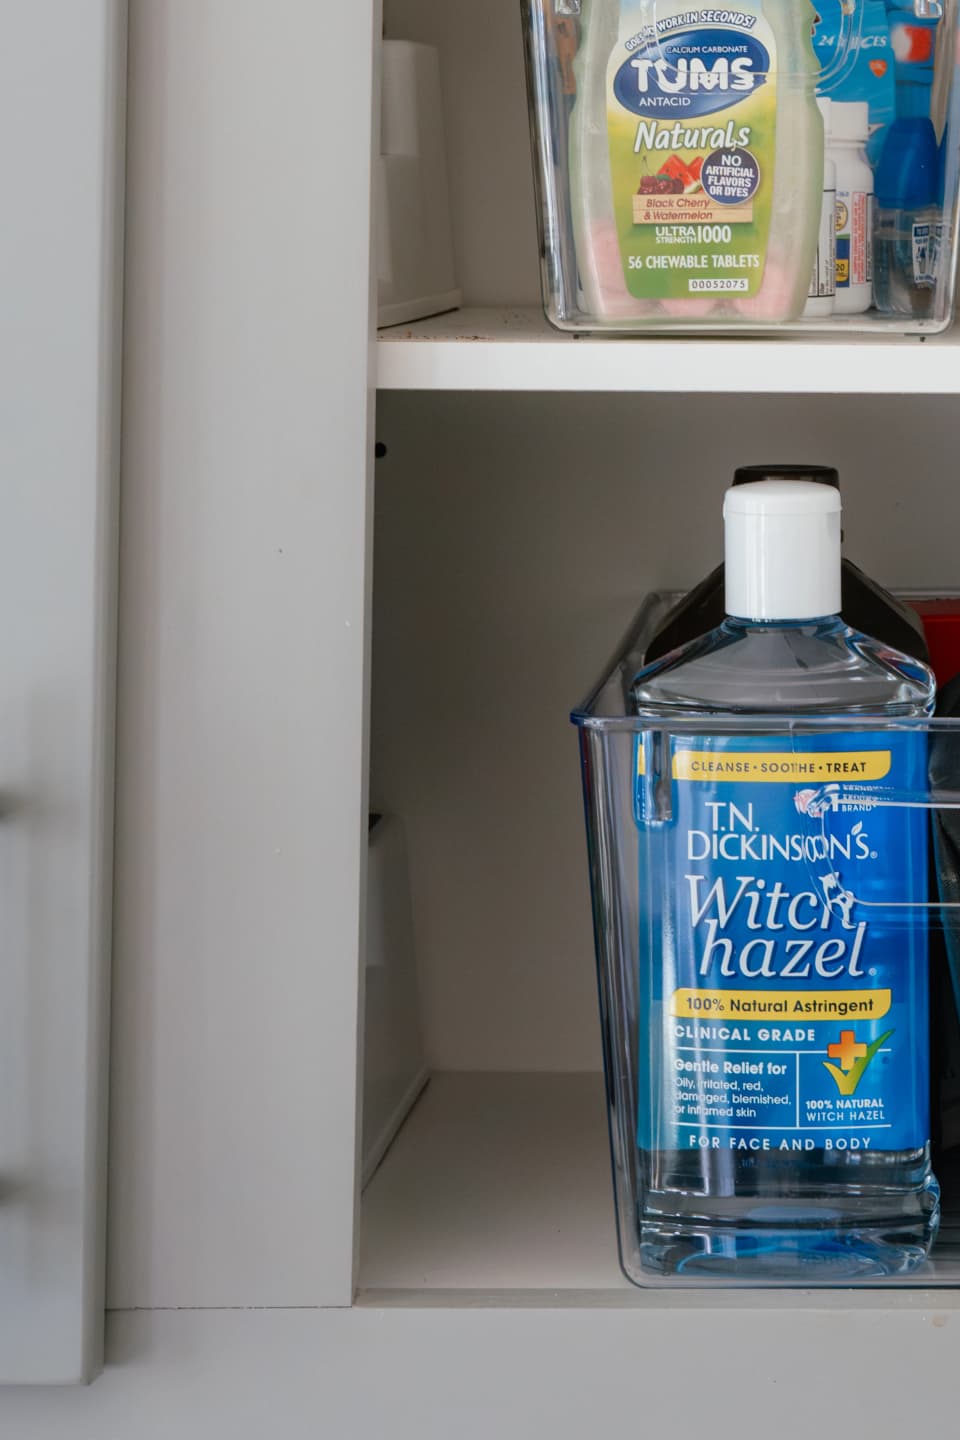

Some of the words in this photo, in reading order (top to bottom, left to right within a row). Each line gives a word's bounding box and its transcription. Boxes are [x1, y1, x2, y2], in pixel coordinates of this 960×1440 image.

[656, 16, 685, 32] WORK
[686, 11, 698, 24] IN
[700, 10, 756, 28] SECONDS!
[818, 35, 835, 47] 24
[666, 46, 700, 54] CALCIUM
[702, 46, 748, 54] CARBONATE
[631, 57, 754, 93] TUMS
[640, 96, 690, 107] ANTACID
[634, 120, 750, 152] Naturals
[721, 155, 742, 166] NO
[706, 167, 754, 178] ARTIFICIAL
[708, 176, 752, 188] FLAVORS
[710, 187, 724, 196] OR
[725, 188, 749, 198] DYES
[646, 199, 673, 208] Black
[676, 199, 710, 210] Cherry
[644, 212, 651, 220] &
[653, 211, 712, 220] Watermelon
[656, 226, 696, 236] ULTRA
[698, 225, 732, 244] 1000
[656, 236, 697, 244] STRENGTH
[628, 256, 642, 270] 56
[646, 255, 708, 269] CHEWABLE
[712, 254, 760, 268] TABLETS
[692, 280, 746, 290] 00052075
[691, 761, 750, 772] CLEANSE
[760, 762, 816, 772] SOOTHE
[826, 762, 867, 772] TREAT
[842, 804, 872, 812] BRAND
[705, 802, 760, 832] T.N.
[685, 872, 857, 930] Witch
[700, 919, 866, 978] hazel
[686, 998, 725, 1011] 100%
[730, 999, 788, 1012] Natural
[793, 998, 874, 1016] Astringent
[674, 1026, 751, 1040] CLINICAL
[758, 1028, 816, 1042] GRADE
[674, 1059, 718, 1073] Gentle
[723, 1062, 764, 1074] Relief
[767, 1062, 787, 1074] for
[676, 1078, 696, 1089] Oily,
[742, 1081, 764, 1092] red,
[674, 1091, 730, 1104] damaged,
[806, 1100, 832, 1110] 100%
[836, 1098, 884, 1110] NATURAL
[675, 1106, 686, 1114] or
[688, 1105, 734, 1117] infamed
[736, 1108, 757, 1118] skin
[806, 1112, 844, 1122] WITCH
[850, 1110, 886, 1120] HAZEL
[689, 1135, 720, 1148] FOR
[730, 1137, 770, 1150] FACE
[780, 1138, 815, 1151] AND
[825, 1137, 871, 1150] BODY
